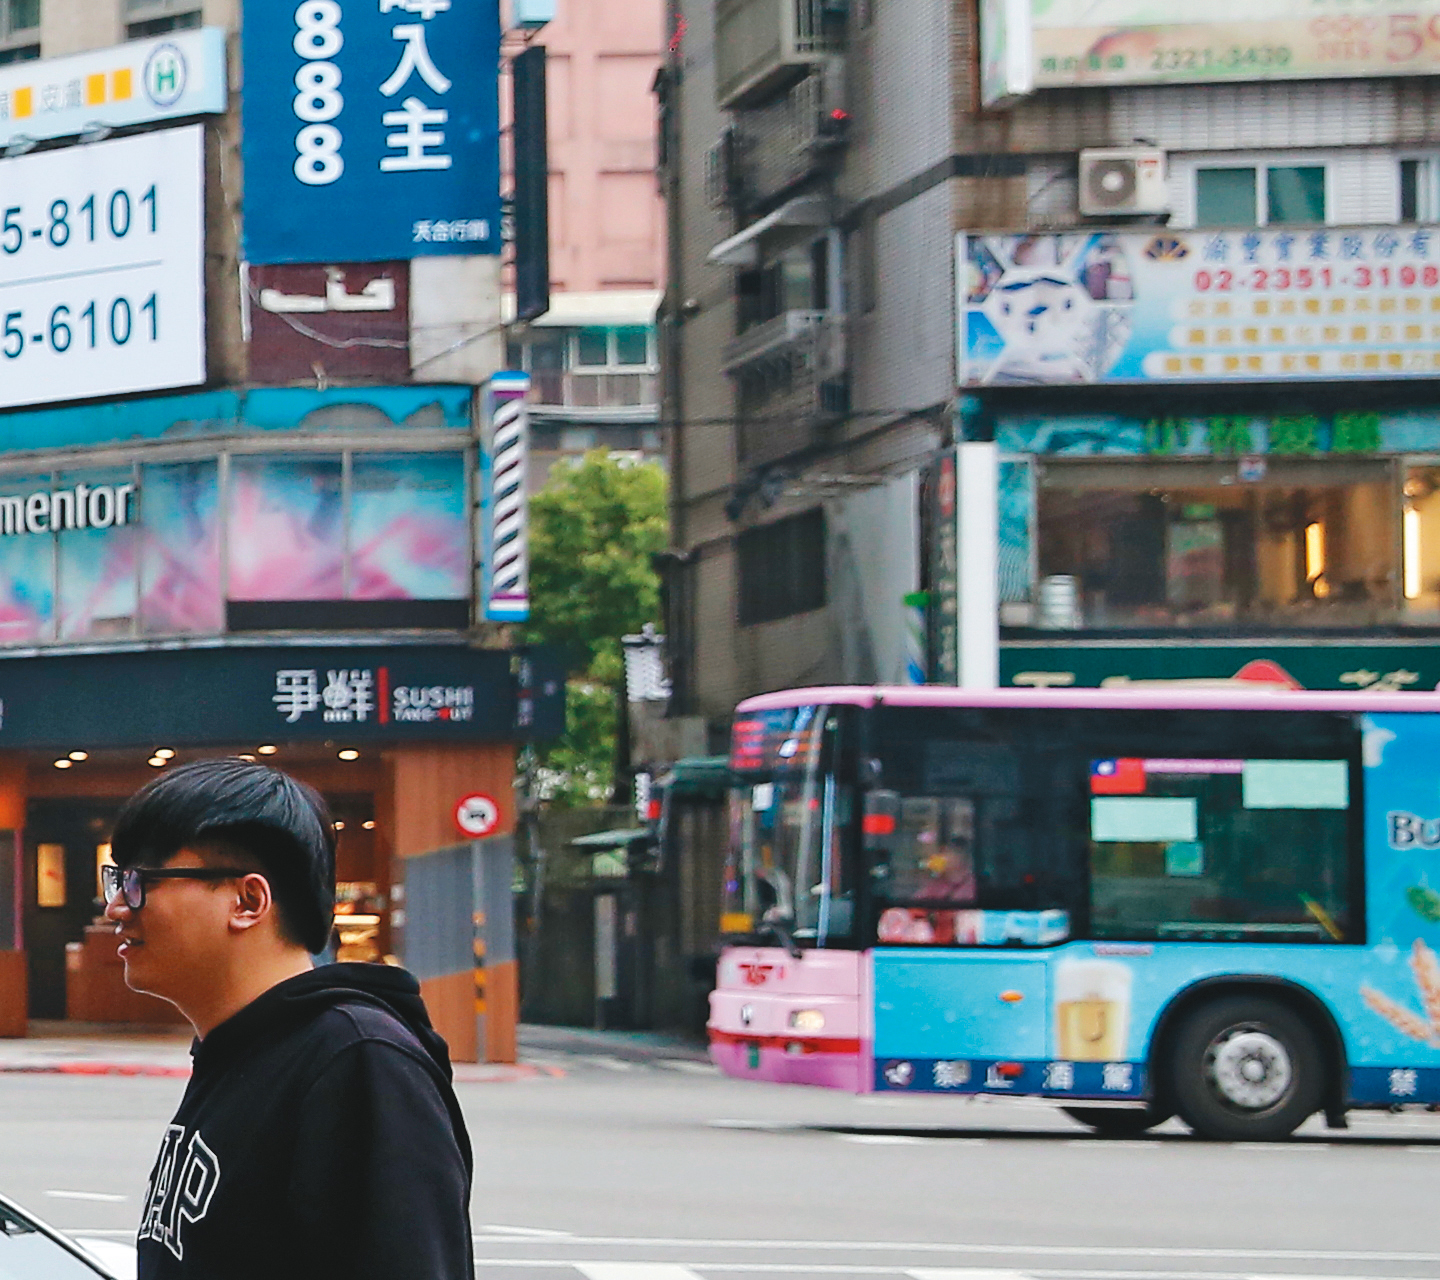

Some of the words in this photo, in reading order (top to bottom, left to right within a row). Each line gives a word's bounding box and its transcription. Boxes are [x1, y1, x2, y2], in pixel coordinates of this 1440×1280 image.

[272, 669, 376, 724] 爭鮮
[393, 685, 474, 708] SUSHI
[139, 1123, 221, 1261] AP
